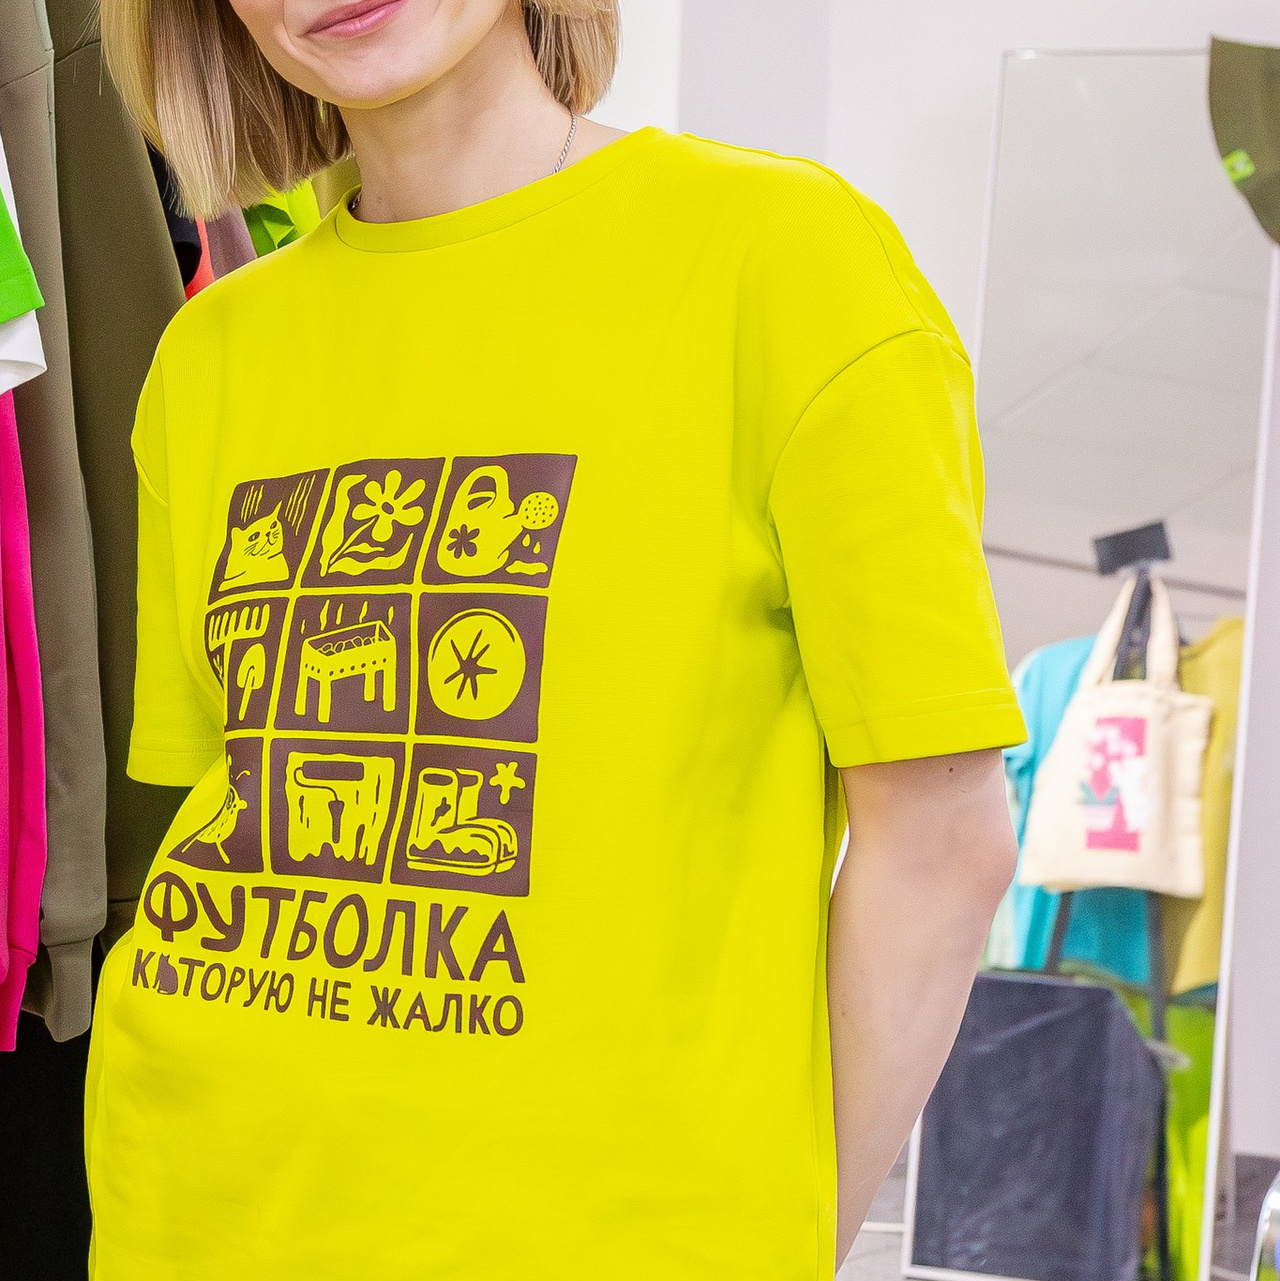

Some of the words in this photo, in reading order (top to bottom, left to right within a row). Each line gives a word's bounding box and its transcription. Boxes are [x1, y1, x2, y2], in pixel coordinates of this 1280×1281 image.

[143, 870, 526, 984] ФУТБОЛКА
[307, 977, 351, 1021] НЕ
[366, 984, 524, 1037] ЖАЛКО
